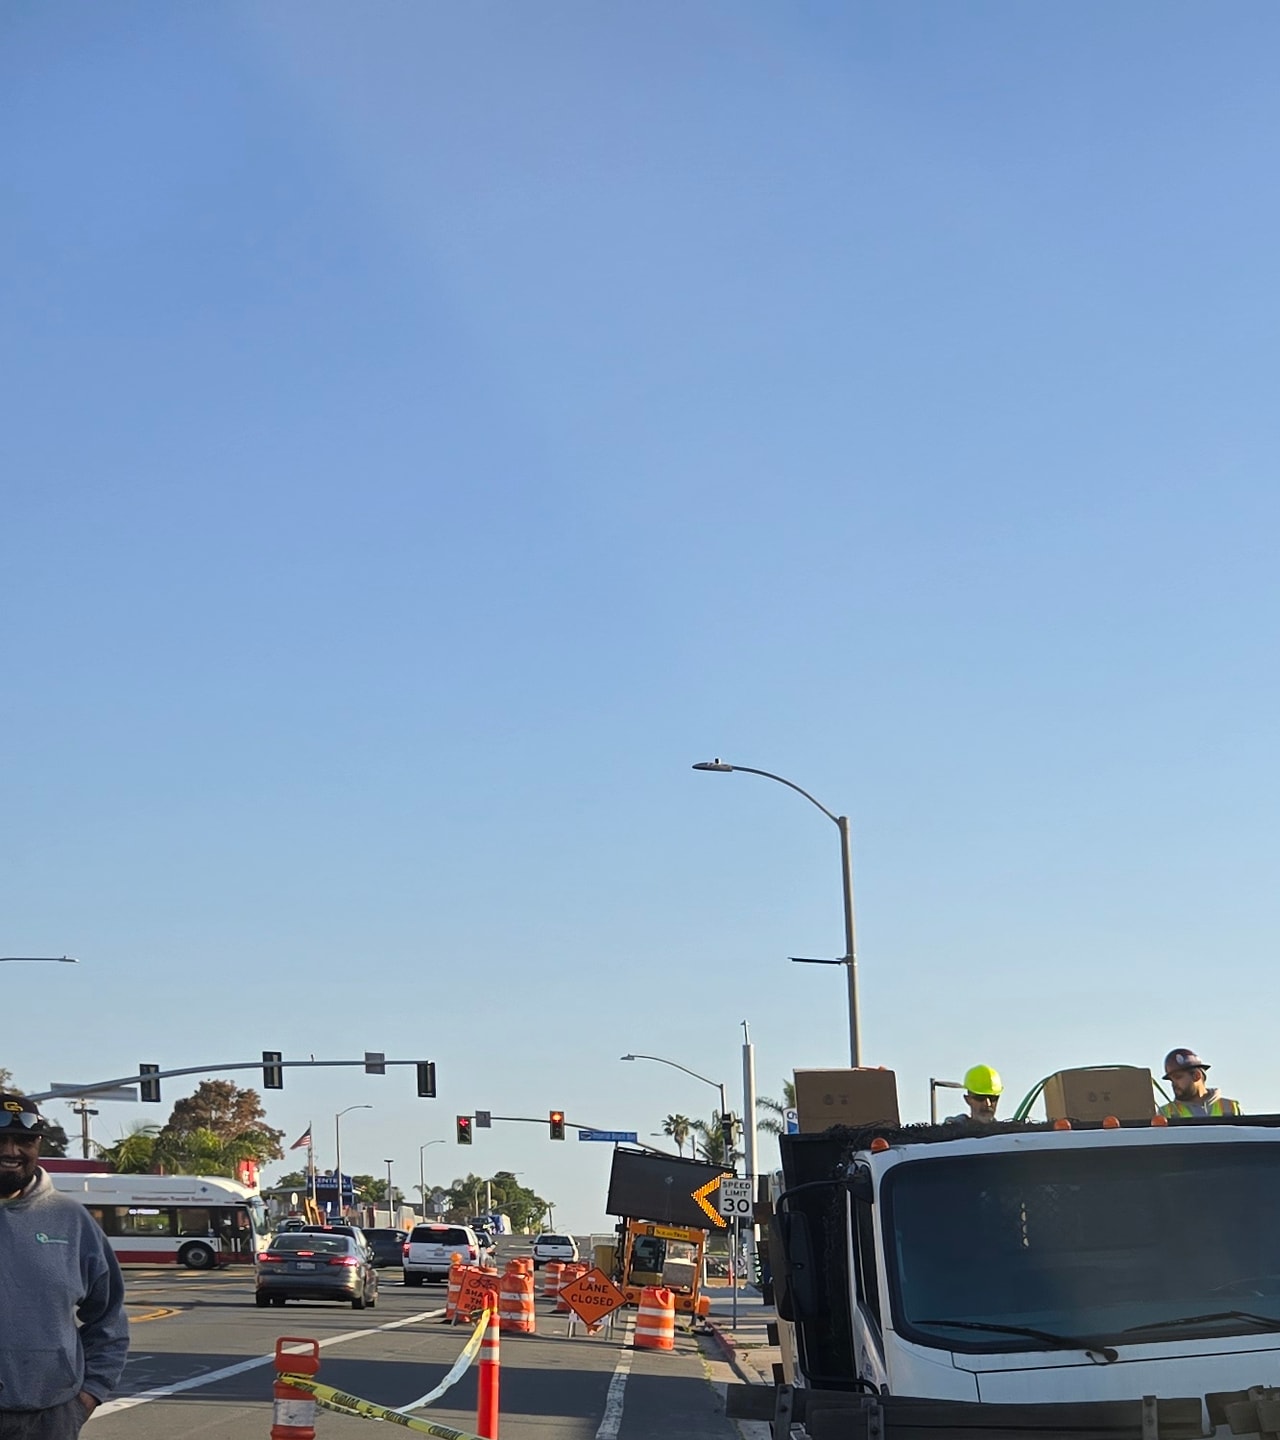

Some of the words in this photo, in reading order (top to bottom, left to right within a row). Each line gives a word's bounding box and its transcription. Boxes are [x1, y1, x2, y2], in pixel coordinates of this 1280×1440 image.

[722, 1180, 751, 1190] SPEED
[725, 1189, 748, 1198] LIMIT
[723, 1198, 750, 1213] 30
[465, 1288, 483, 1299] SHA
[579, 1281, 609, 1295] LANE
[571, 1293, 614, 1308] CLOSED
